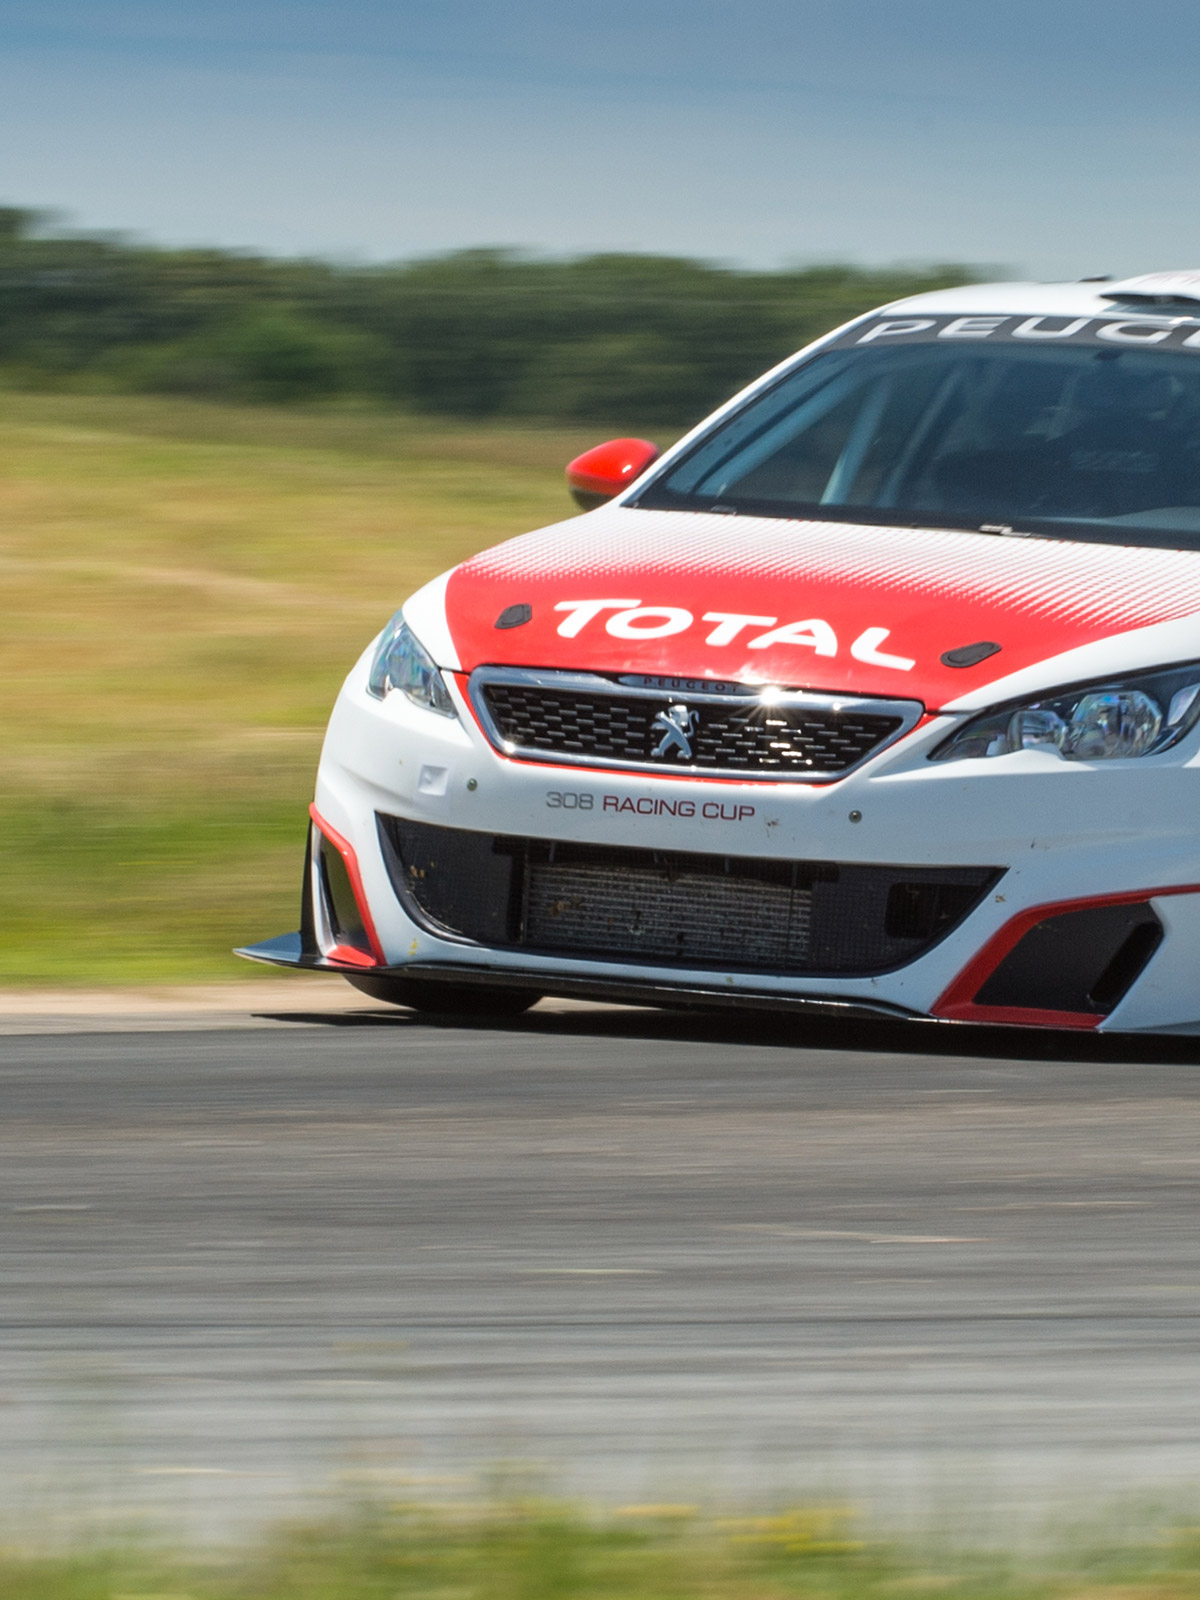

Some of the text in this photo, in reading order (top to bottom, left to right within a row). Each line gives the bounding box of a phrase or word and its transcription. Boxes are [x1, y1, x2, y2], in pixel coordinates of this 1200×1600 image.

[554, 599, 916, 671] TOTAL
[643, 676, 737, 693] PEUGEOT
[546, 791, 755, 821] 308 RACING CUP
